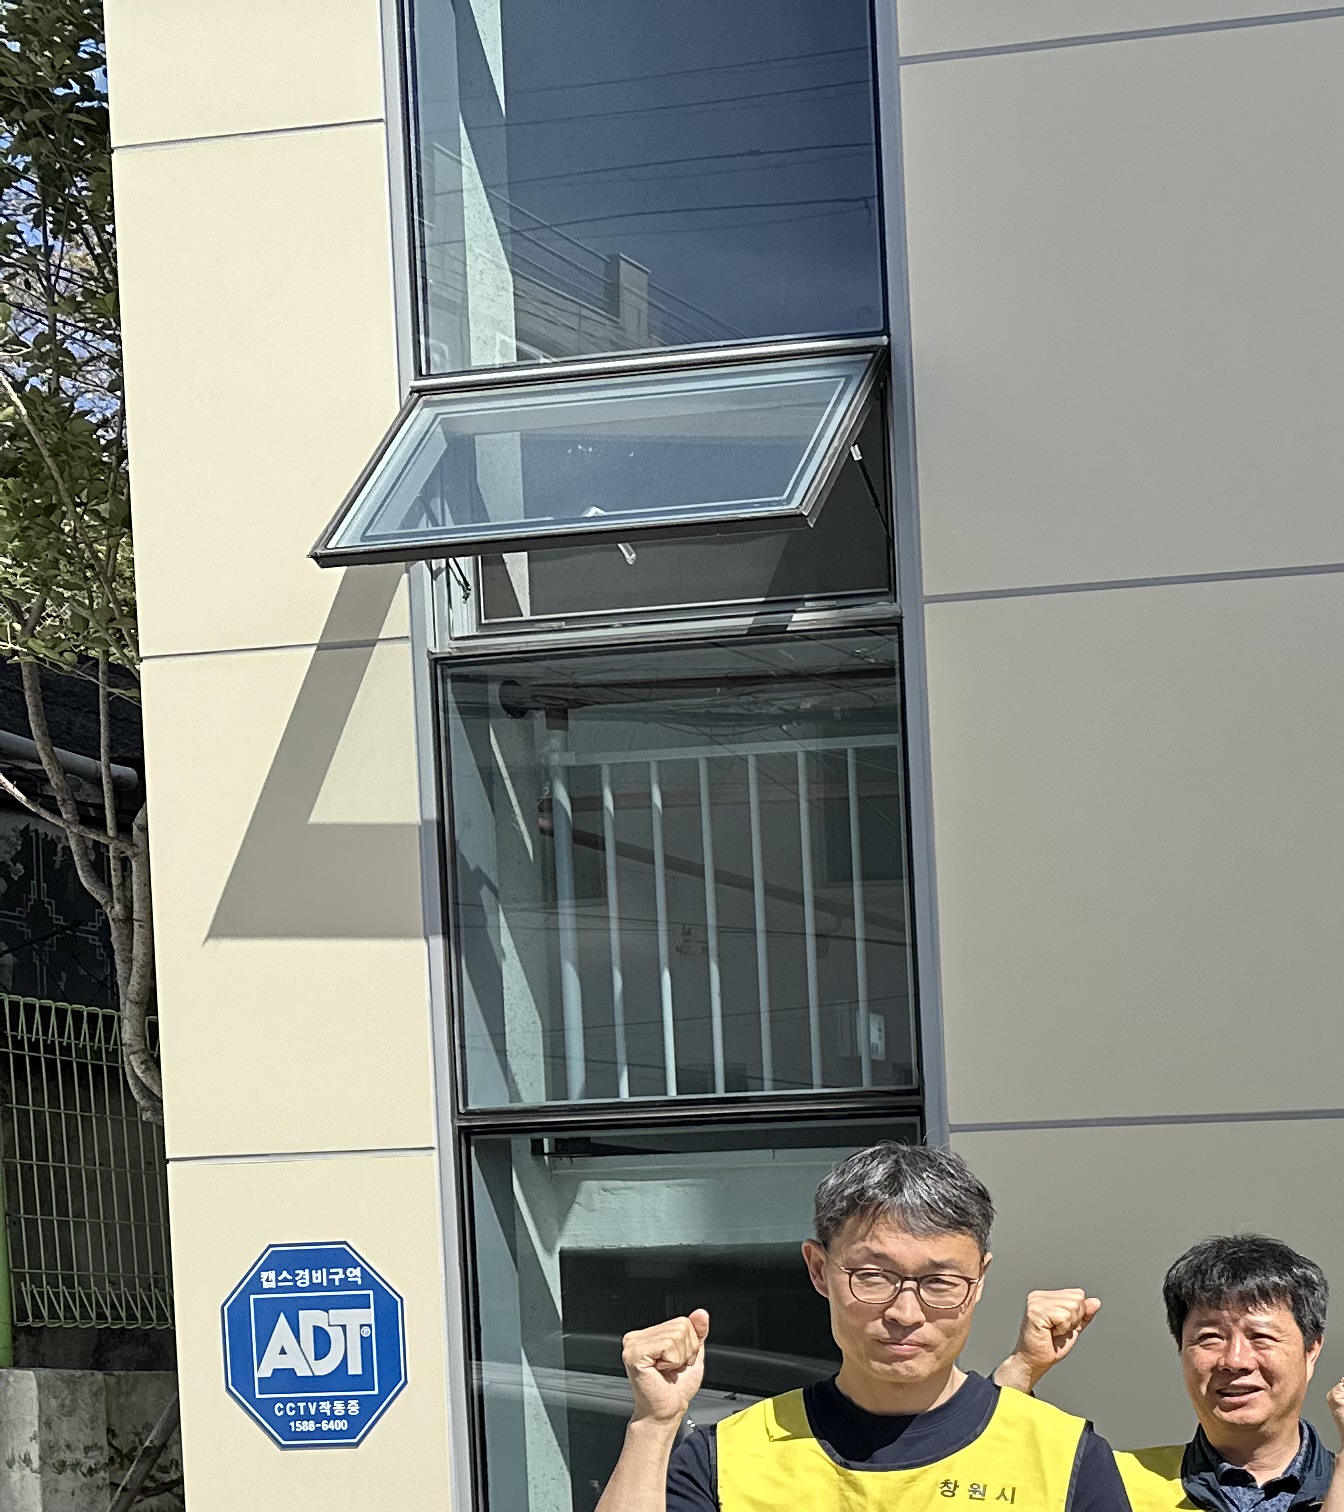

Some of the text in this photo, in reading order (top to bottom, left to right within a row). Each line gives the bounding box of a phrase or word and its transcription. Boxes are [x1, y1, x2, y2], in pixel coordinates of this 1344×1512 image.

[259, 1267, 362, 1289] 캡스경비구역
[257, 1308, 373, 1378] ADT
[274, 1399, 361, 1417] CCTV작동중
[289, 1418, 348, 1432] 1588-6400
[938, 1477, 1018, 1507] 창원시
